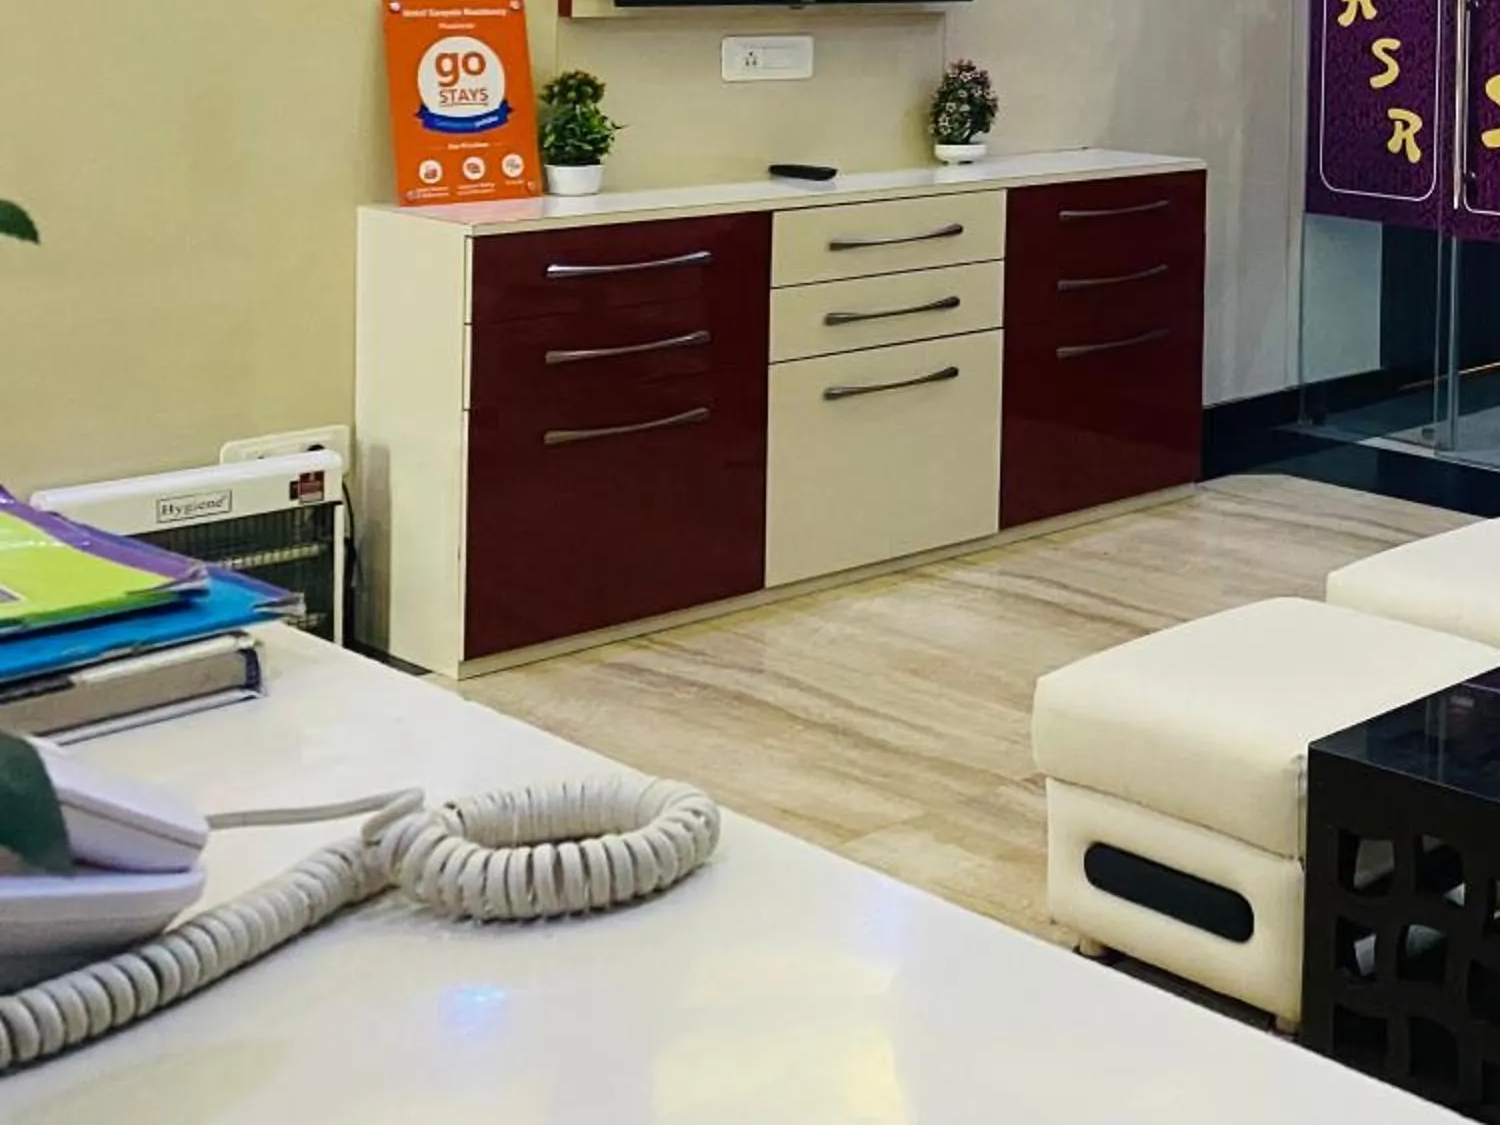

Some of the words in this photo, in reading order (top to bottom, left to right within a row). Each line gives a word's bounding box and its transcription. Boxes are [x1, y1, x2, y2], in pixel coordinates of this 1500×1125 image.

[435, 51, 486, 87] go
[1369, 38, 1401, 88] S
[439, 88, 488, 104] STAYS
[1387, 108, 1423, 163] R
[161, 496, 225, 517] Hygiene
